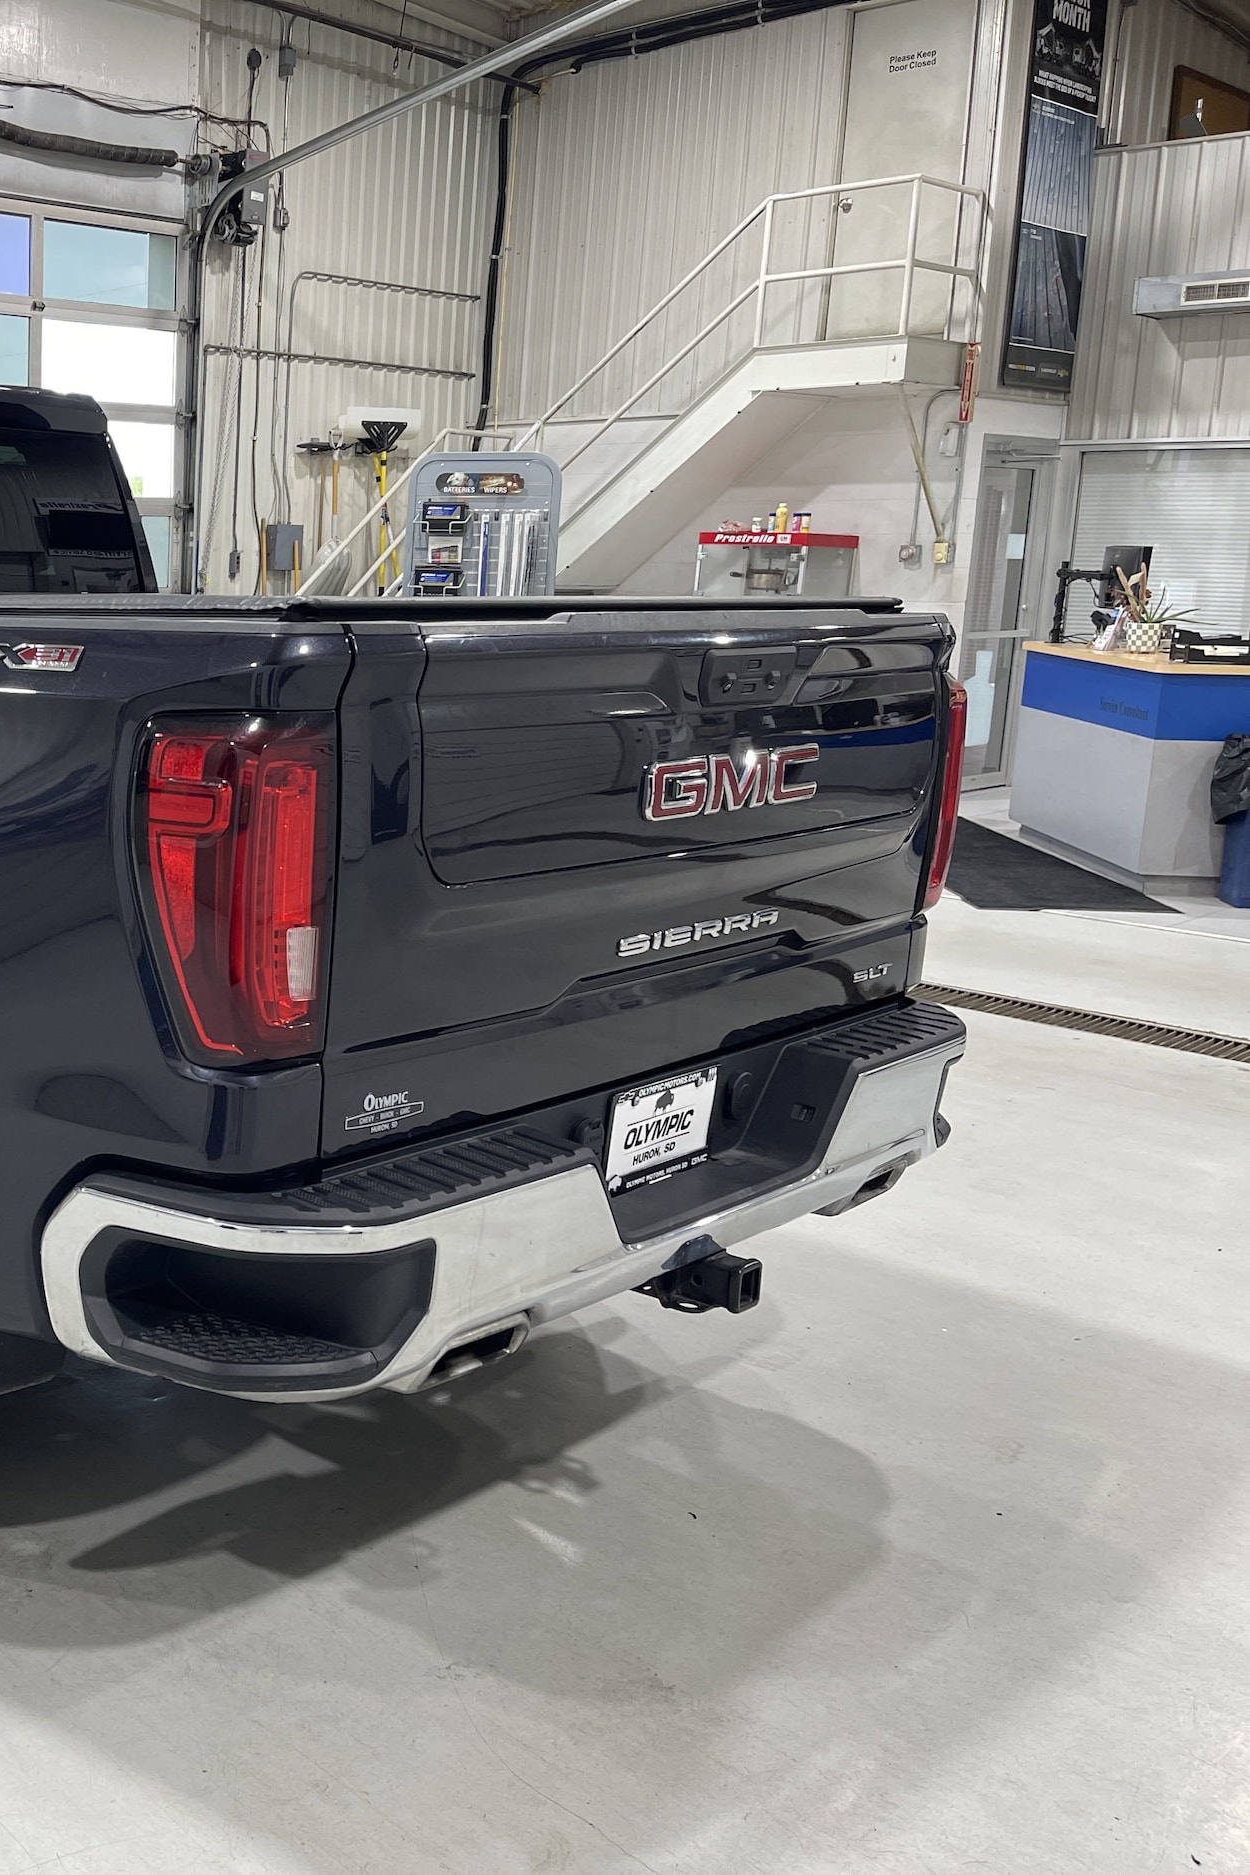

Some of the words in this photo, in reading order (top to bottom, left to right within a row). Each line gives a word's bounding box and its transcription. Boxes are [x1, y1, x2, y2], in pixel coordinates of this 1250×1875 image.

[1053, 0, 1091, 33] MONTH
[889, 54, 915, 64] Please
[916, 50, 937, 60] Keep
[889, 64, 909, 73] Door
[909, 57, 937, 70] Closed
[483, 486, 508, 494] WIPERS
[714, 533, 775, 543] Prostrollo
[639, 743, 820, 821] GMC
[617, 908, 779, 957] SIERRA
[852, 962, 893, 984] SLT
[363, 1091, 409, 1112] OLYMPIC
[359, 1114, 375, 1125] CHEVY
[623, 1109, 695, 1151] OLYMPIC
[632, 1147, 661, 1167] HURON,
[664, 1141, 676, 1153] SD
[626, 1176, 646, 1189] OLYMPIC
[691, 1153, 708, 1166] GMC
